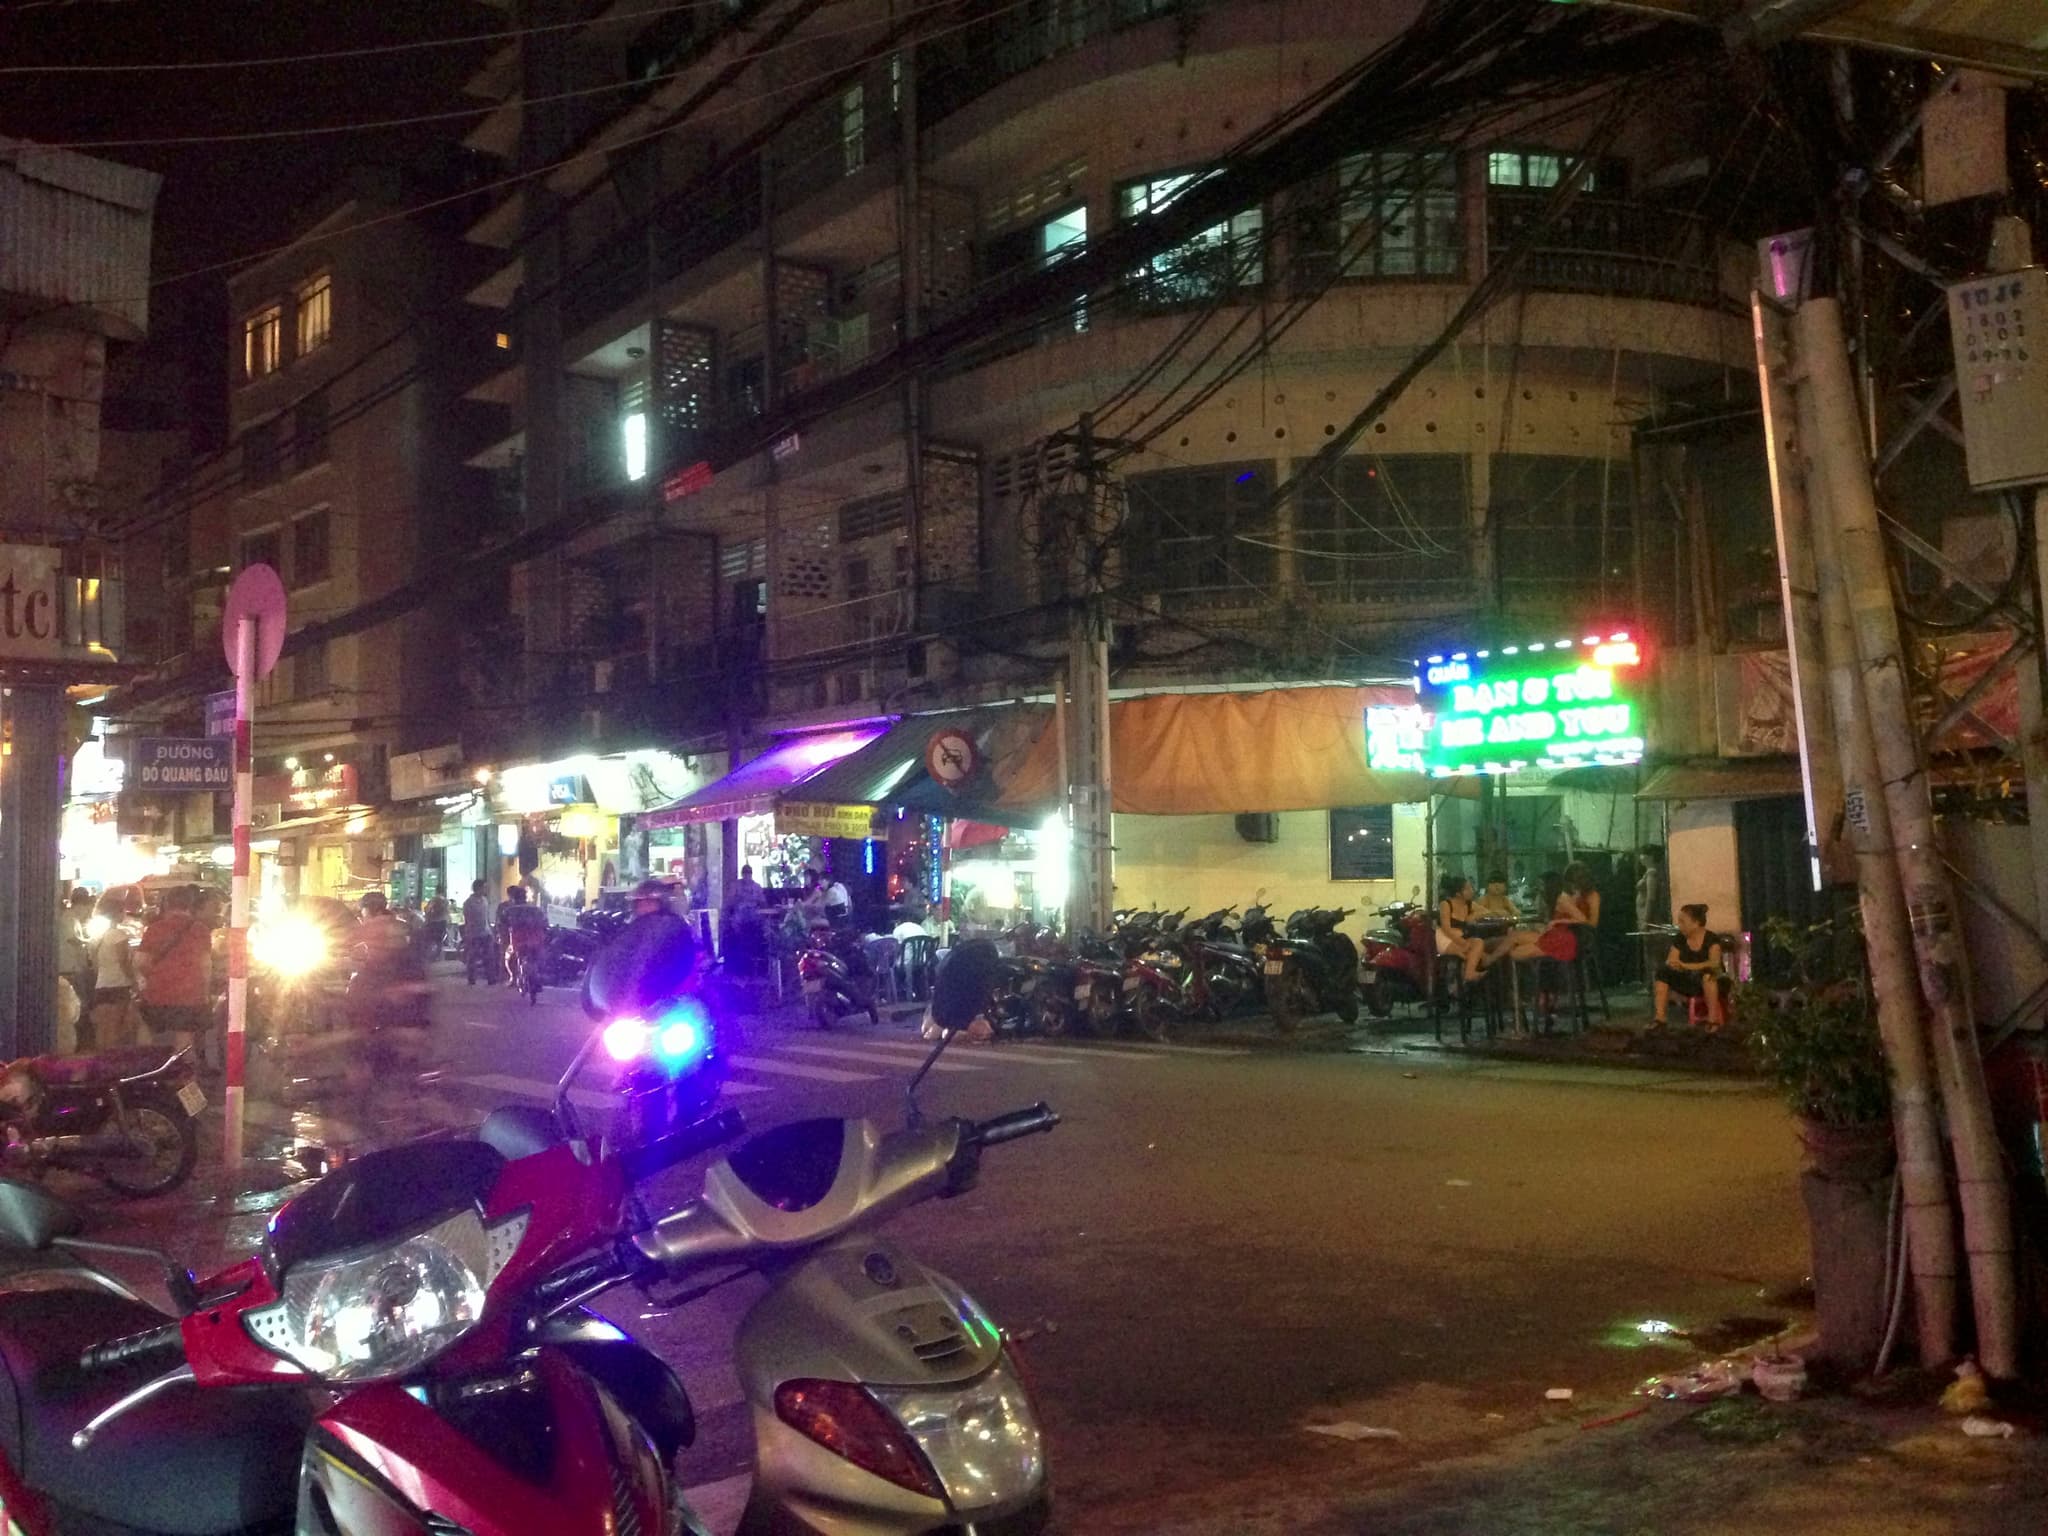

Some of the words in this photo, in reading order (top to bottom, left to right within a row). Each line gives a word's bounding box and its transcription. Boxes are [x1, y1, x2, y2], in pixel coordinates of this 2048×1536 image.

[1441, 717, 1484, 746] ME
[1487, 711, 1556, 743] AND
[1558, 704, 1630, 736] YOU
[162, 766, 202, 782] QUANG
